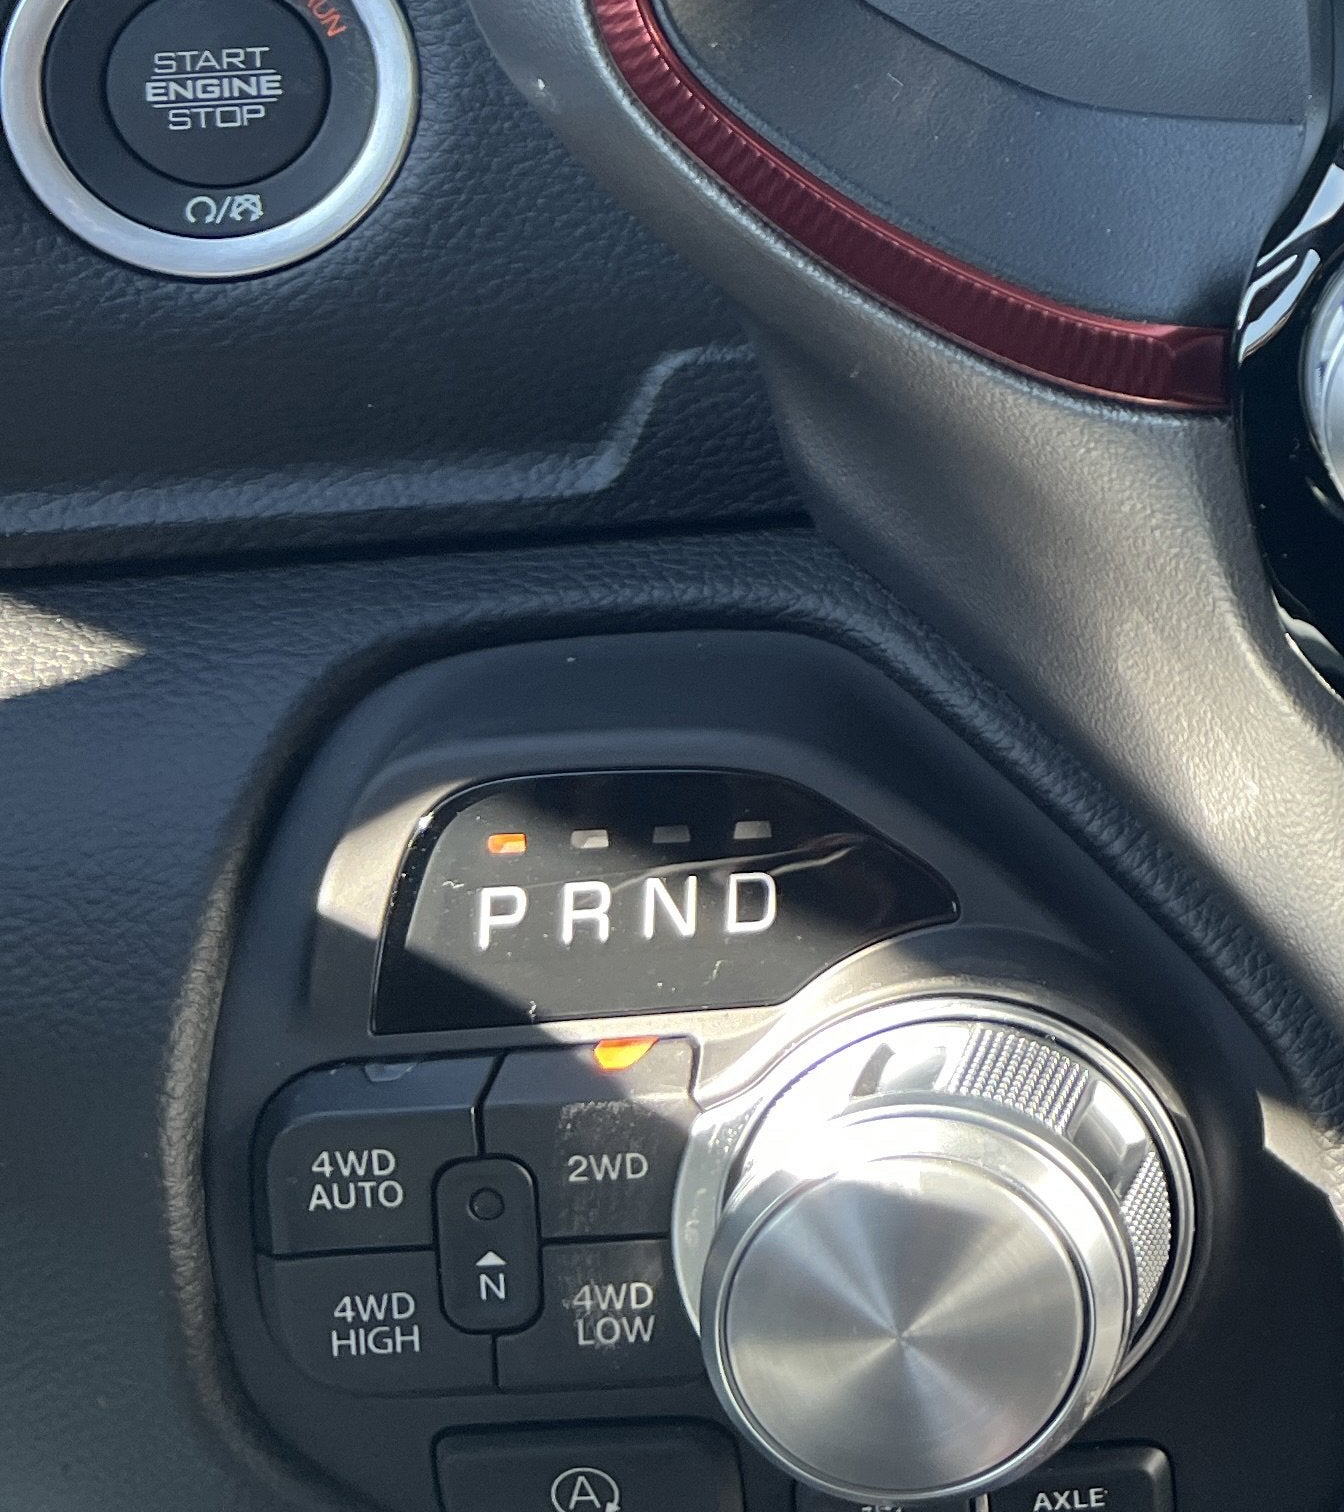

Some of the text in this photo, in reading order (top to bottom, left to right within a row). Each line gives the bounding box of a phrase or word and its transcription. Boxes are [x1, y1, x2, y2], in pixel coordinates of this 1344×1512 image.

[153, 46, 271, 74] START
[145, 74, 284, 103] ENGINE
[168, 104, 267, 131] STOP
[310, 1149, 397, 1179] 4WD
[567, 1152, 650, 1184] 2WD
[308, 1179, 405, 1211] AUTO
[478, 1272, 507, 1301] N
[571, 1281, 654, 1311] 4WD
[332, 1291, 416, 1322] 4WD
[330, 1325, 421, 1357] HIGH
[576, 1315, 655, 1346] LOW
[1033, 1488, 1105, 1512] AXLE
